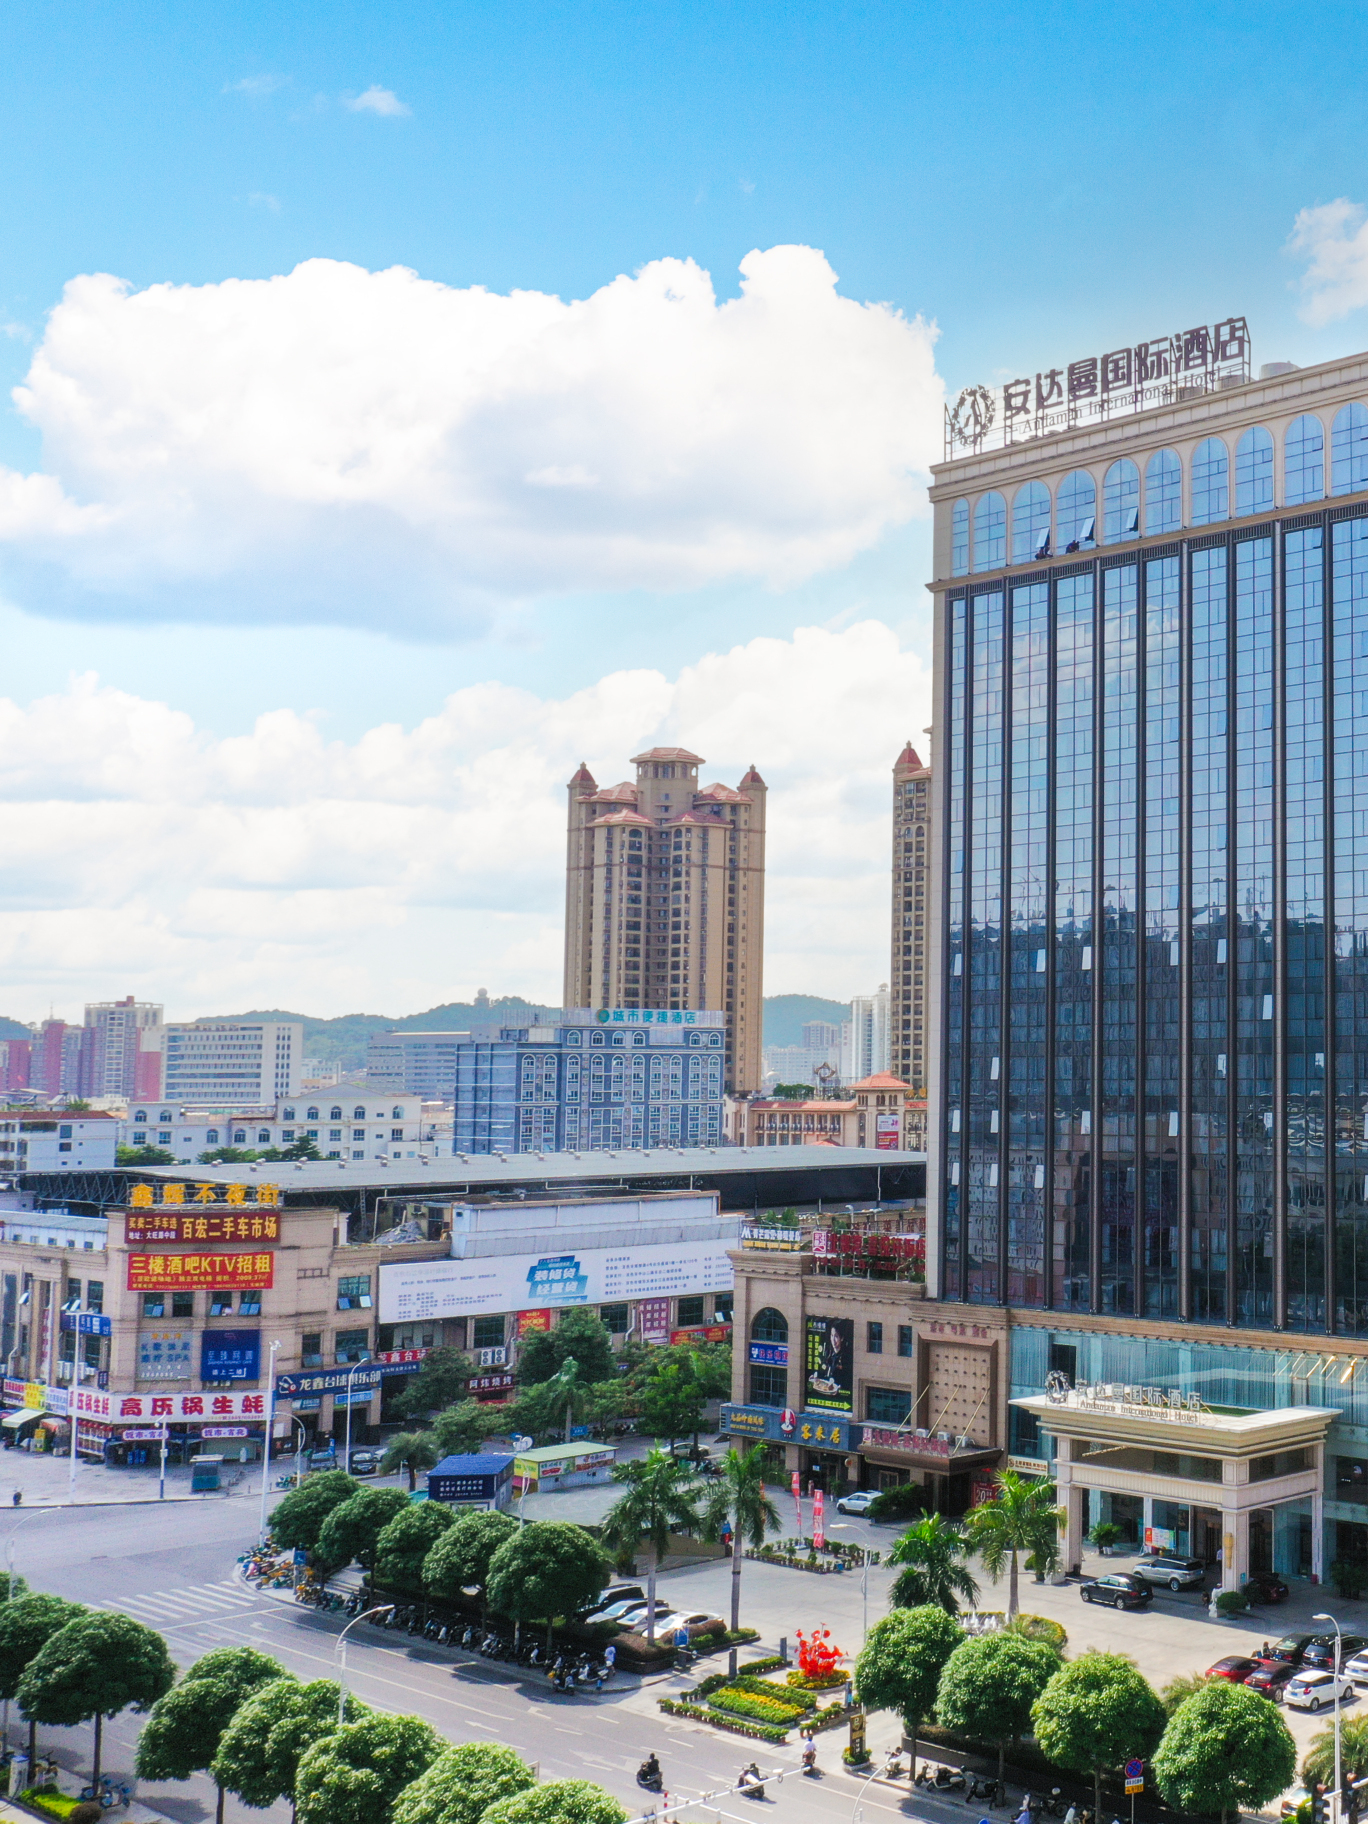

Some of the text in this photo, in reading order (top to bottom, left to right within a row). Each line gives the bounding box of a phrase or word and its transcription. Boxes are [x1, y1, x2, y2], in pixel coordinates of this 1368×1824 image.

[1003, 316, 1246, 424] 安达曼国际酒店
[612, 1009, 697, 1024] 城市便捷酒店
[181, 1216, 277, 1239] 百宏二手车市场
[130, 1254, 271, 1275] 三楼酒吧KTV招租
[120, 1394, 265, 1417] 高压锅生蚝
[1075, 1379, 1201, 1411] 安达曼国际酒店
